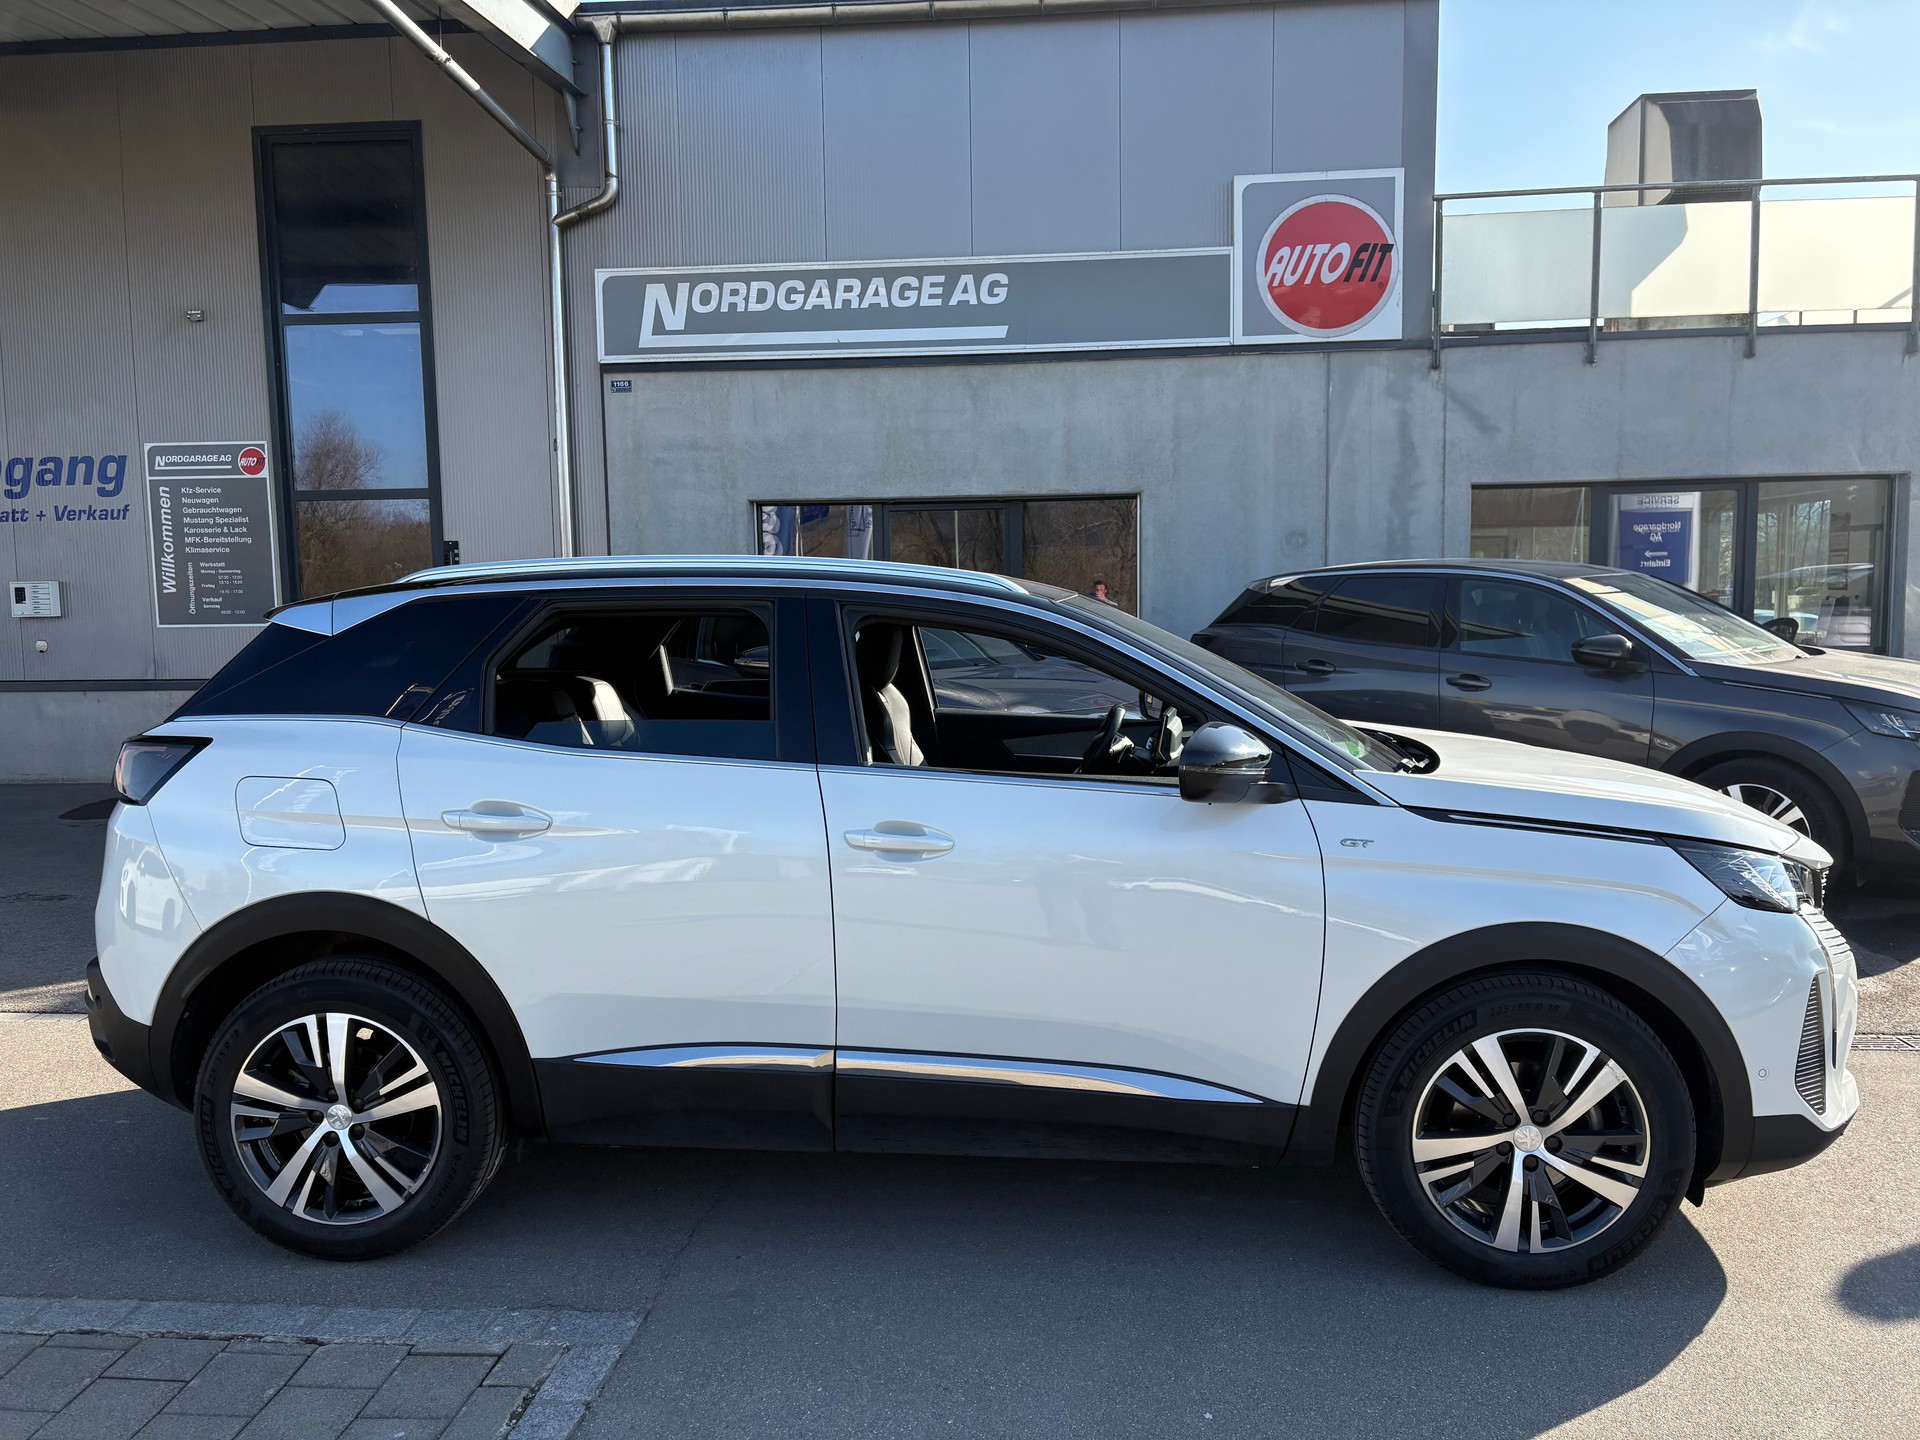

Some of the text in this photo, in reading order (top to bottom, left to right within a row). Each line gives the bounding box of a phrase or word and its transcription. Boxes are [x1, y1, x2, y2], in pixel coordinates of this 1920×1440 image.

[1265, 242, 1394, 287] AUTOFIT
[640, 273, 1009, 334] NORDGARAGE AG
[155, 454, 232, 468] NORDGARAGE AG
[0, 455, 127, 499] gang
[181, 486, 222, 494] Kfz-Service
[36, 510, 46, 521] +
[54, 504, 130, 522] Verkauf
[182, 507, 242, 515] Gebrauchtwagen
[215, 516, 249, 524] Spezialist
[160, 486, 177, 594] Willkommen
[185, 536, 252, 544] MFK-Bereitstellung
[186, 546, 230, 554] Klimaservice
[1340, 838, 1375, 848] GT
[1398, 1011, 1475, 1090] MICHELIN
[436, 1051, 468, 1144] MICHELIN
[201, 1097, 235, 1192] MICHELIN
[1591, 1199, 1668, 1273] MICHELIN
